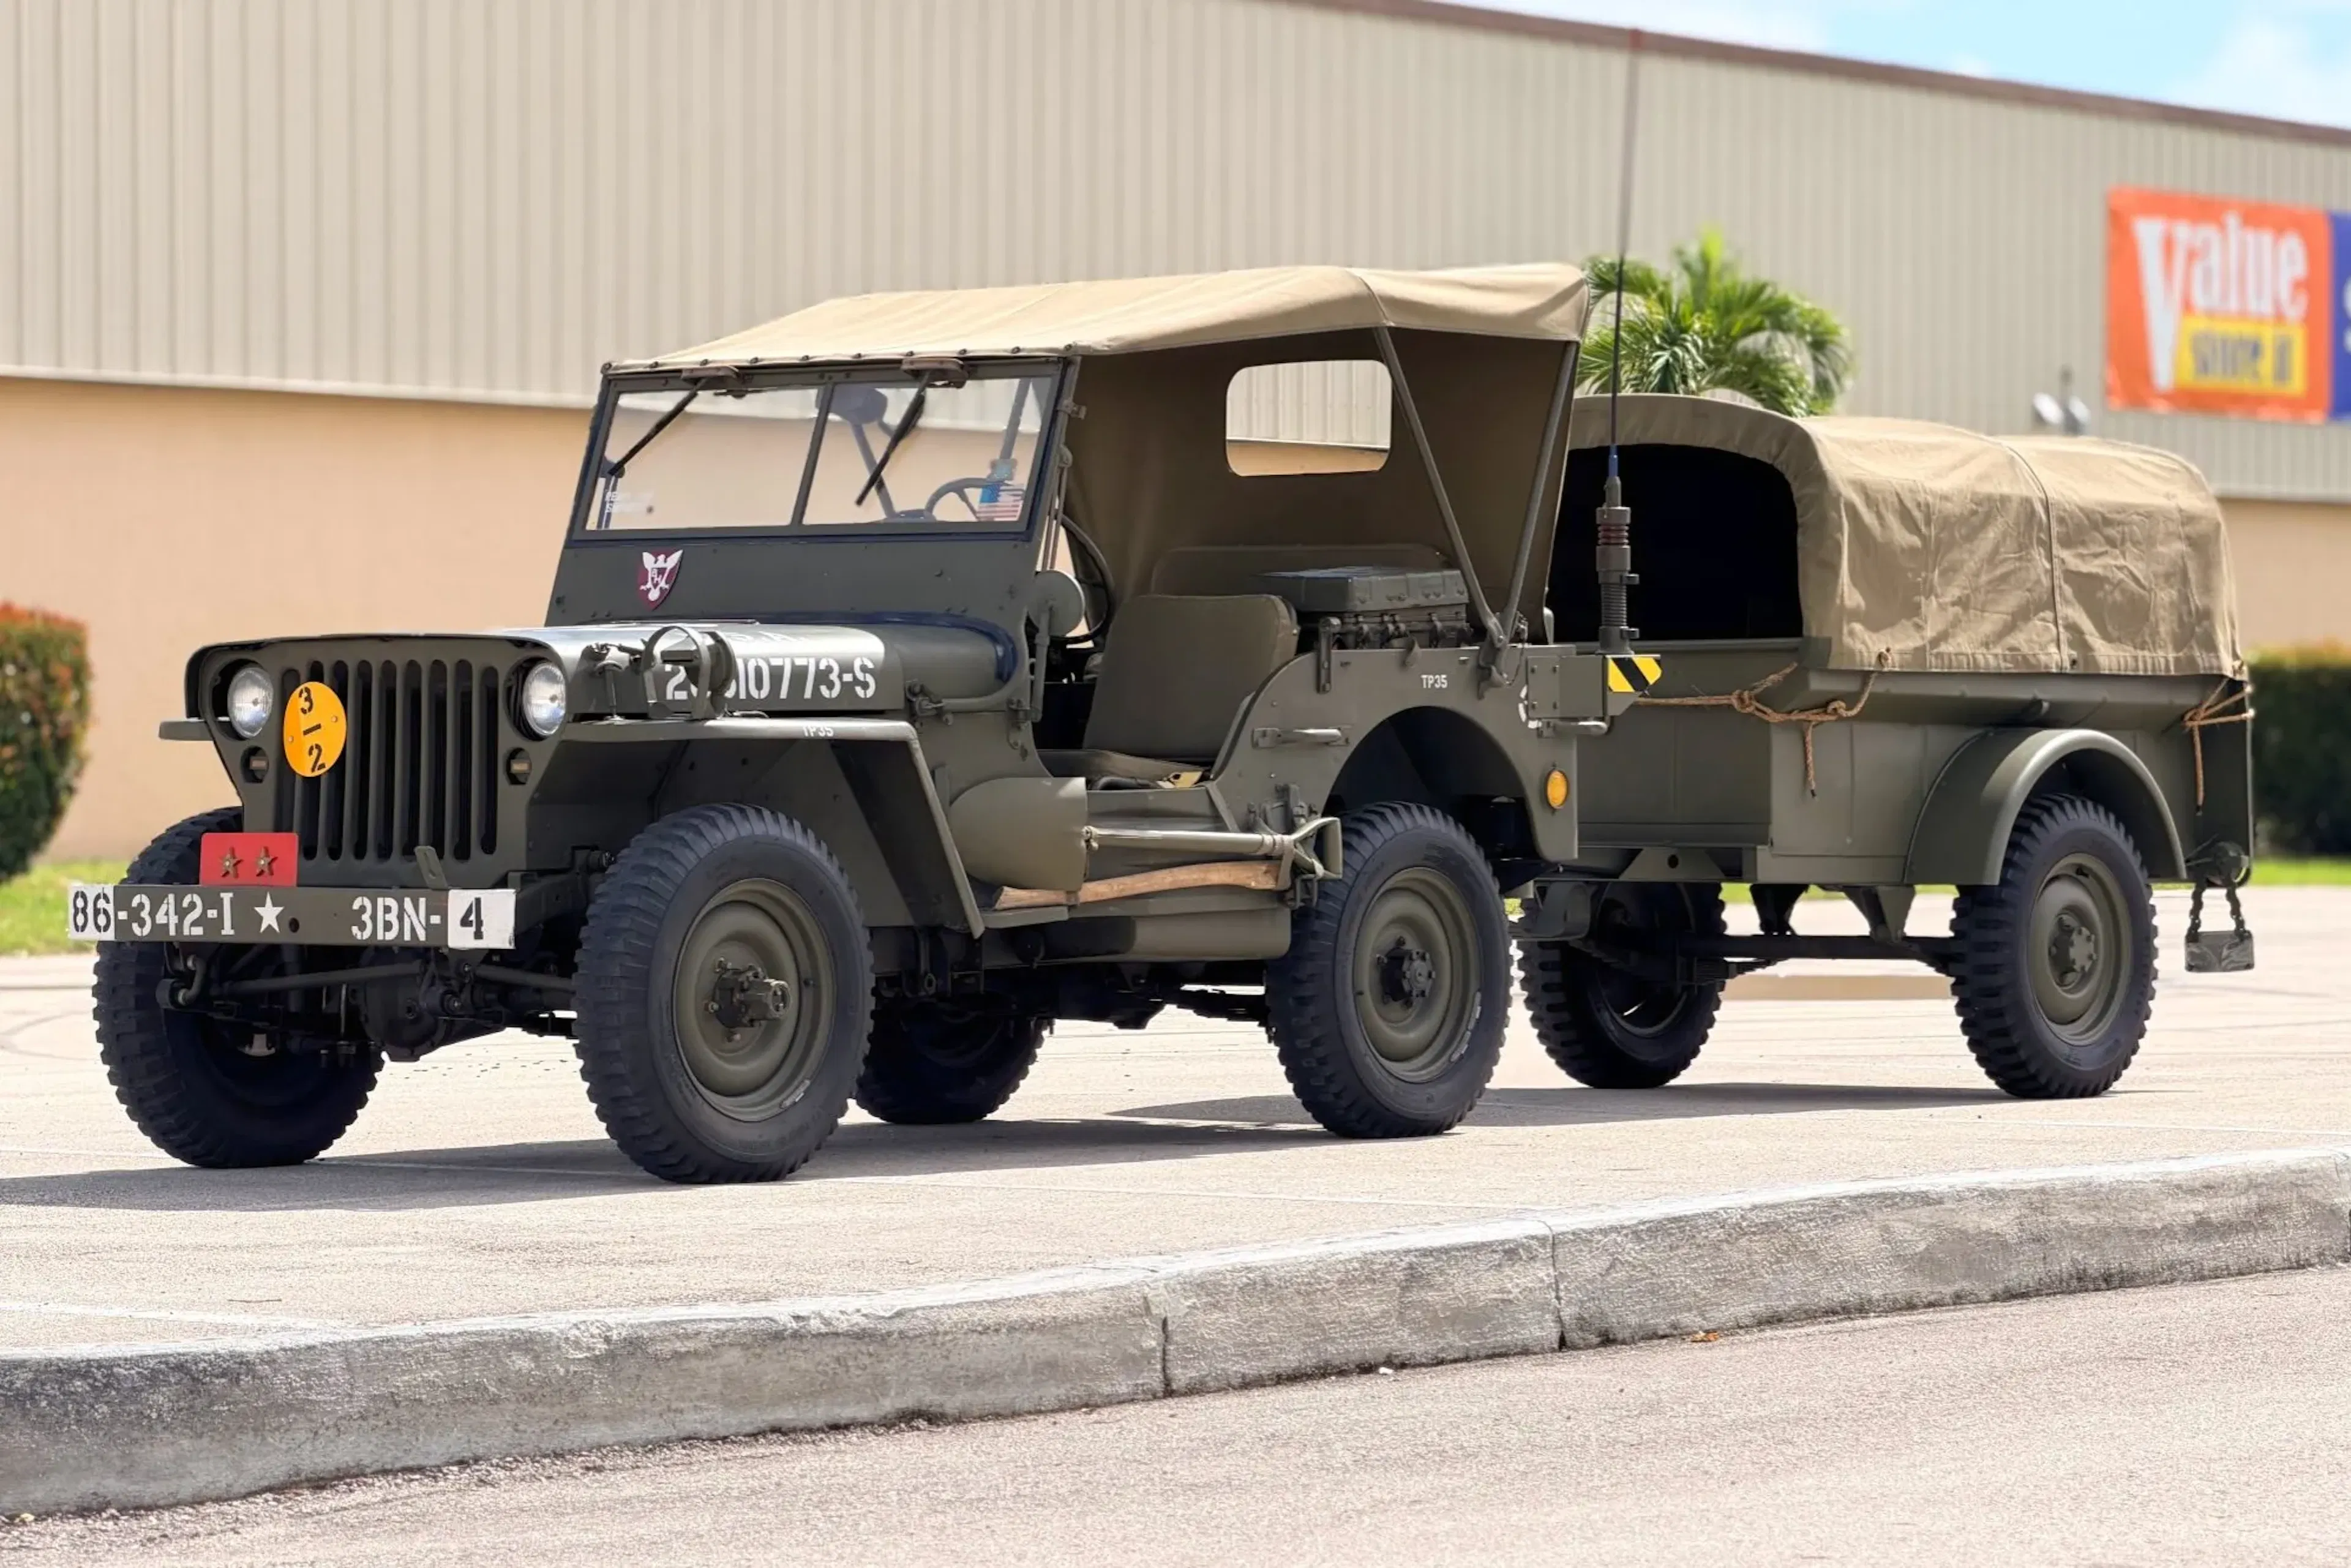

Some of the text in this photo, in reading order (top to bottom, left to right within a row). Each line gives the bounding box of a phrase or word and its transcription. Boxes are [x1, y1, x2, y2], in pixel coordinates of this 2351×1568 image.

[2132, 213, 2308, 391] Value
[664, 657, 876, 700] 210773-S
[1420, 675, 1448, 689] TP35
